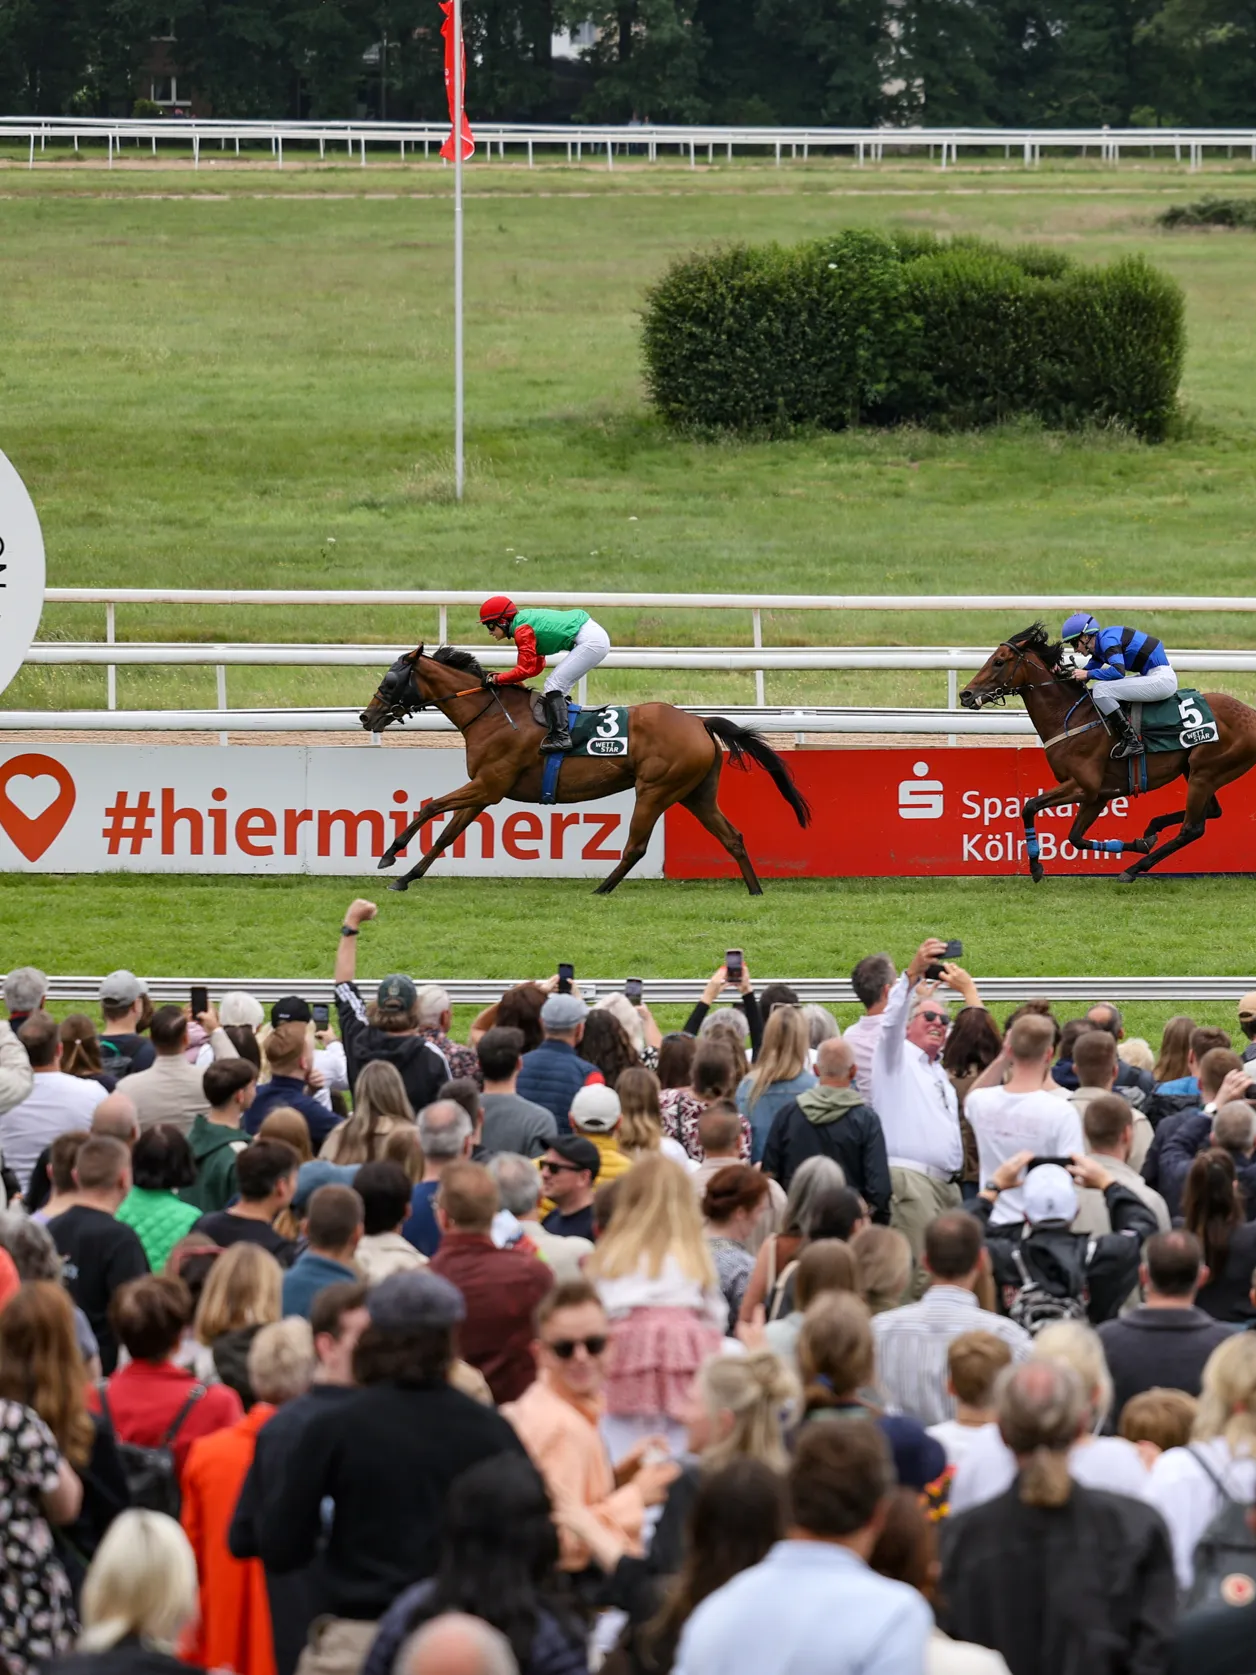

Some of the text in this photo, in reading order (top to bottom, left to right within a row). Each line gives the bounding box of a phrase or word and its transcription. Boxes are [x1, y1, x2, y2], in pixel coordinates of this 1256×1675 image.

[596, 709, 620, 738] 3
[1178, 697, 1203, 728] 5
[1186, 729, 1205, 739] WETT
[1193, 733, 1210, 743] STAR
[962, 788, 1130, 826] Spakae
[102, 786, 622, 861] #hiermitherz
